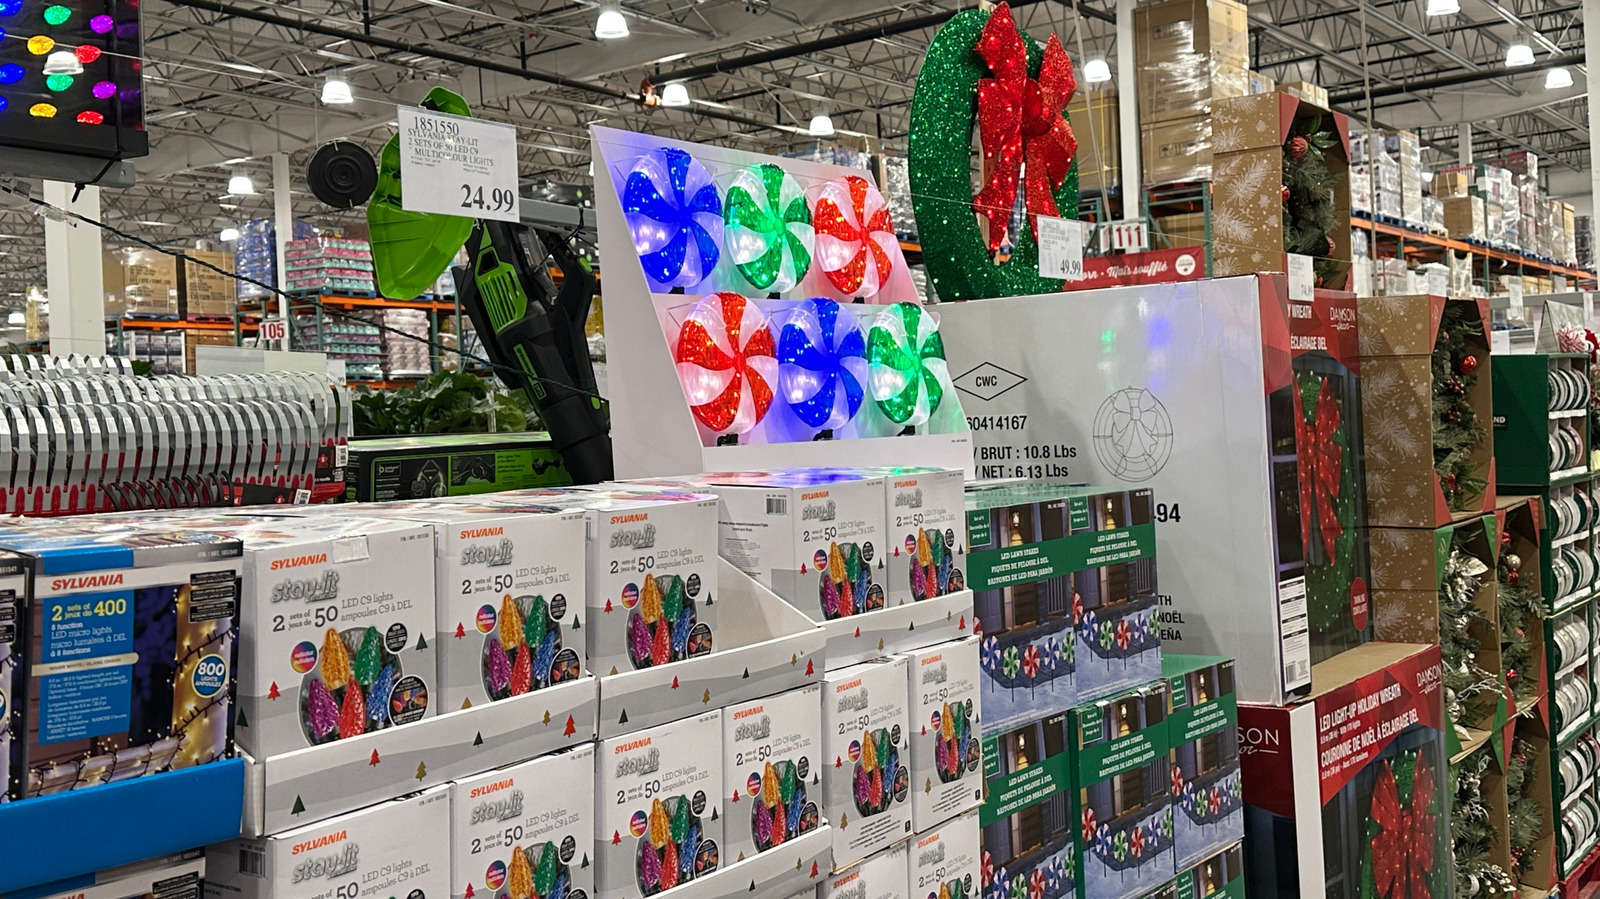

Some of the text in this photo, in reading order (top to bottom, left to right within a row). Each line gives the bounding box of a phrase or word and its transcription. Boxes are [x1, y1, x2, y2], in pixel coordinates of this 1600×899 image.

[415, 117, 459, 136] 1851550
[408, 128, 478, 146] SYLVANIA STAY-LIT
[415, 138, 432, 148] SETS
[434, 140, 443, 150] OF
[454, 144, 468, 154] LED
[470, 146, 479, 155] C9
[415, 148, 468, 162] MULTICOLOUR
[470, 155, 494, 166] LIGHTS
[460, 184, 514, 212] 24.99
[1115, 226, 1142, 247] 111
[1060, 259, 1080, 275] 49.99
[1292, 304, 1312, 319] WREATH
[1330, 307, 1355, 321] DAMSON
[261, 323, 285, 339] 105
[1291, 333, 1328, 350] ÉCLAIRAGE DEL
[976, 376, 997, 387] CWC
[981, 445, 1076, 460] BRUT 10.8 Lbs
[982, 464, 1068, 478] NET 6.13 Lbs
[801, 491, 829, 501] SYLVANIA
[610, 513, 648, 524] SYLVANIA
[914, 513, 924, 526] 50
[1154, 503, 1181, 523] 94
[460, 527, 503, 539] SYLVANIA
[610, 523, 656, 549] stay-lit
[824, 526, 837, 541] 50
[461, 538, 513, 567] stay-lit
[270, 553, 327, 570] SYLVANIA
[610, 561, 618, 574] 2
[638, 556, 654, 572] 50
[516, 568, 528, 578] LED
[530, 566, 540, 576] C9
[545, 575, 554, 584] C9
[51, 574, 123, 591] SYLVANIA
[271, 570, 340, 603] stay-lit
[462, 580, 472, 594] 2
[494, 574, 512, 592] 50
[94, 598, 126, 616] 400
[342, 592, 394, 609] LED C9 lights
[52, 605, 62, 621] 2
[290, 609, 311, 620] sets of
[315, 606, 338, 627] 50
[341, 600, 413, 621] ampoules C9 à DEL
[1159, 610, 1185, 623] NOËL
[273, 615, 285, 632] 2
[68, 629, 90, 637] micro
[197, 662, 225, 676] 800
[1417, 663, 1442, 687] DAMSON
[836, 678, 862, 693] SYLVANIA
[939, 688, 949, 702] 50
[734, 706, 763, 720] SYLVANIA
[1320, 682, 1402, 732] LED LIGHT-UP HOLIDAY WREATH
[858, 715, 869, 730] 50
[615, 737, 651, 754] SYLVANIA
[1321, 740, 1352, 767] COURONNE
[1353, 735, 1360, 752] DE
[1361, 726, 1376, 748] NOËL
[1377, 722, 1382, 740] À
[1382, 712, 1409, 738] ÉCLAIRAGE
[1409, 708, 1419, 725] DEL
[736, 753, 743, 766] 2
[759, 745, 771, 761] 50
[615, 747, 660, 778] stay-lit
[662, 770, 683, 782] LED C9
[470, 778, 514, 798] SYLVANIA
[645, 779, 660, 798] 50
[617, 790, 625, 804] 2
[470, 790, 524, 824] stay-lit
[526, 813, 550, 828] LED C9
[555, 819, 564, 828] C9
[292, 830, 347, 855] SYLVANIA
[505, 825, 523, 846] 50
[471, 838, 481, 854] 2
[293, 841, 360, 884] stay-lit
[362, 859, 412, 884] LED C9 lights
[935, 869, 945, 883] 50
[361, 864, 430, 896] ampoules C9 DEL
